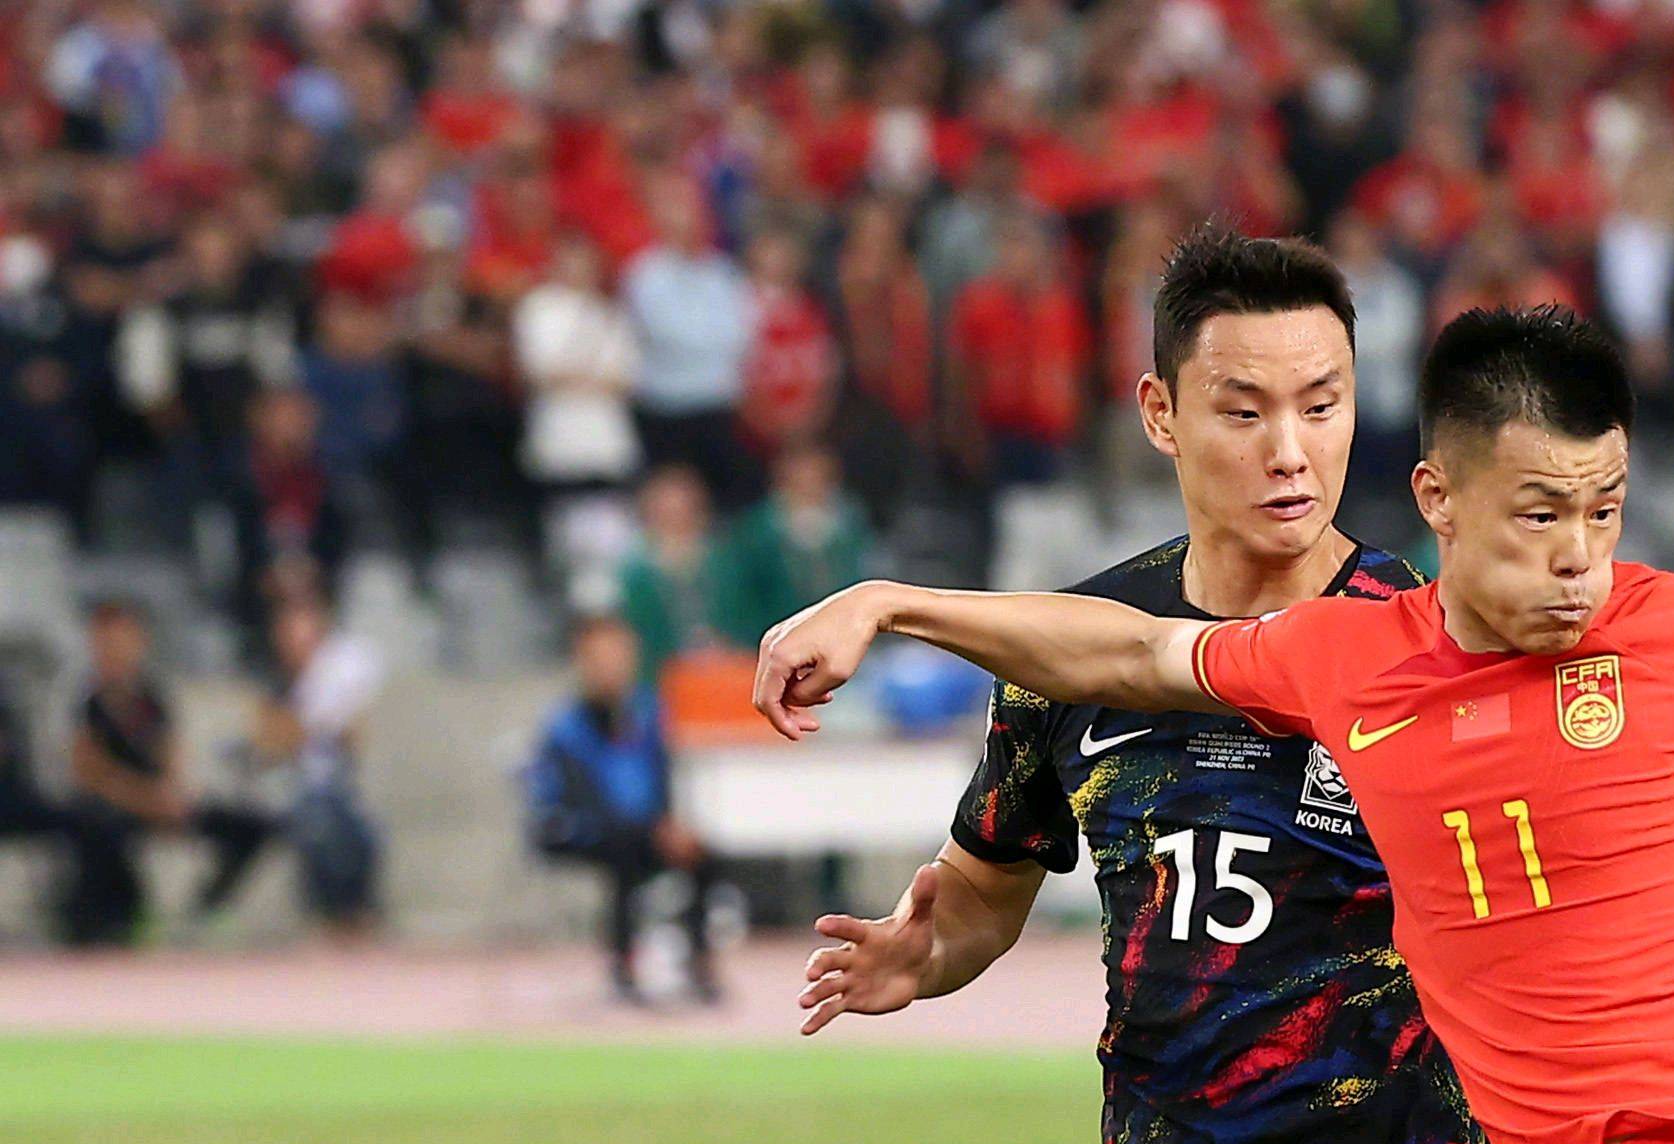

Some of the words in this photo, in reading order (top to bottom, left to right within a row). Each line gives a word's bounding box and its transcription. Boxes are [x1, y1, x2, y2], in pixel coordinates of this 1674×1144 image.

[1561, 660, 1613, 686] CFA
[1294, 809, 1353, 836] KOREA
[1154, 828, 1274, 944] 15
[1442, 798, 1552, 919] 11
